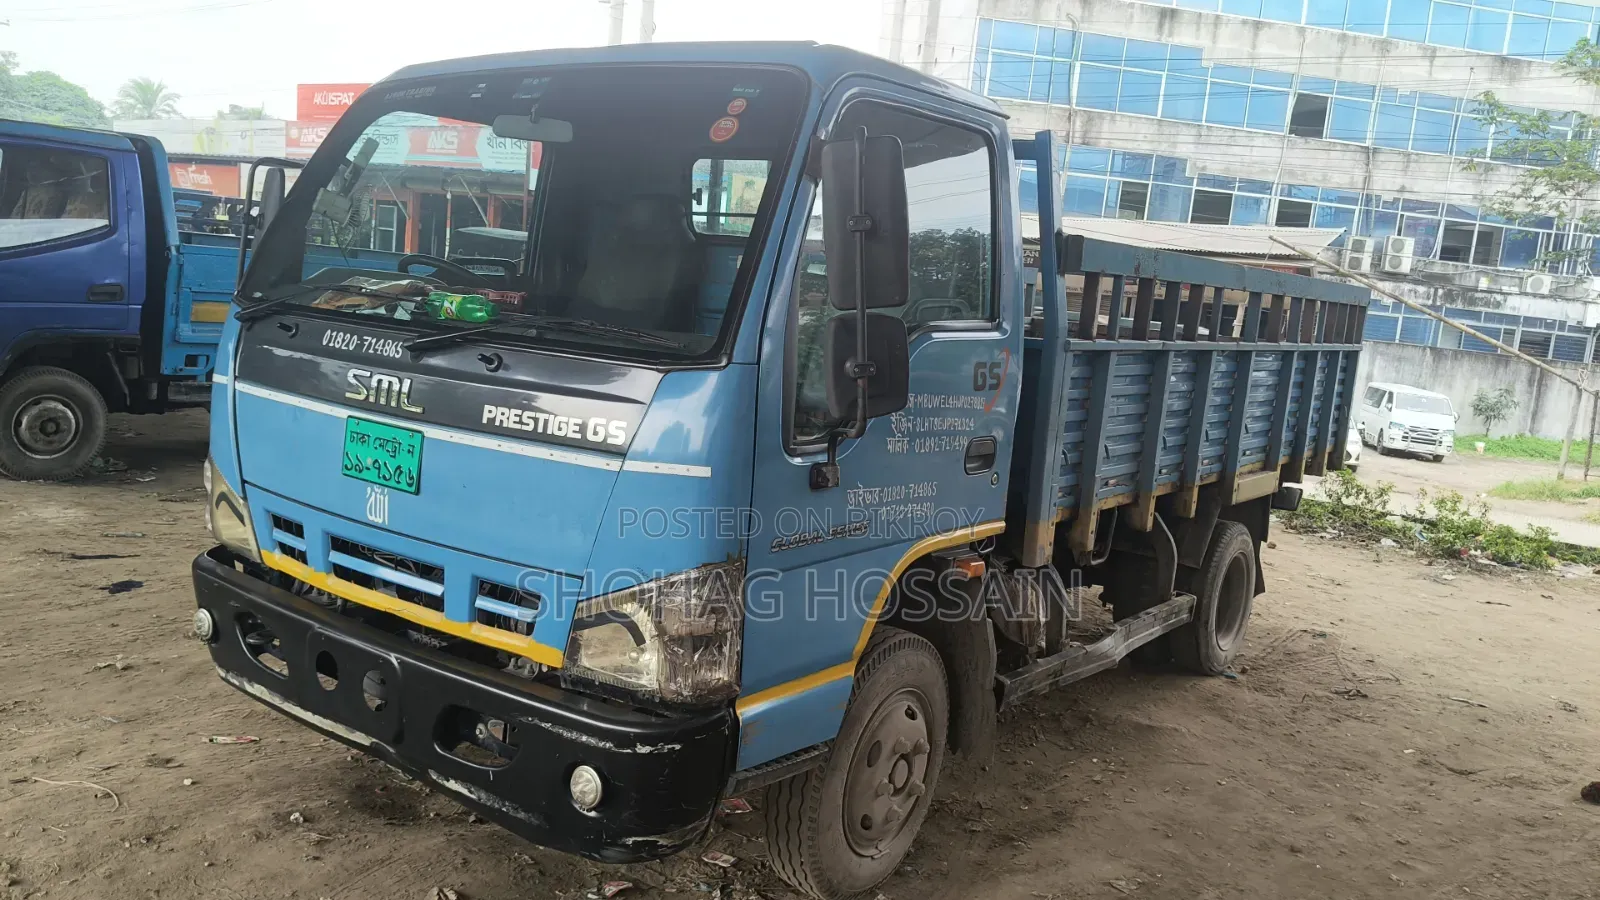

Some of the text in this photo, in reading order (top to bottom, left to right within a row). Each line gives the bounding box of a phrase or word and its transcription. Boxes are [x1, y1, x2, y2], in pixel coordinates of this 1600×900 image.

[322, 329, 404, 358] 01820-714865
[345, 368, 425, 414] SML
[973, 361, 1002, 391] GS
[349, 430, 371, 446] ঢাকা
[481, 403, 628, 445] PRESTIGE GS
[344, 451, 416, 487] ১৯-৭১৫৬
